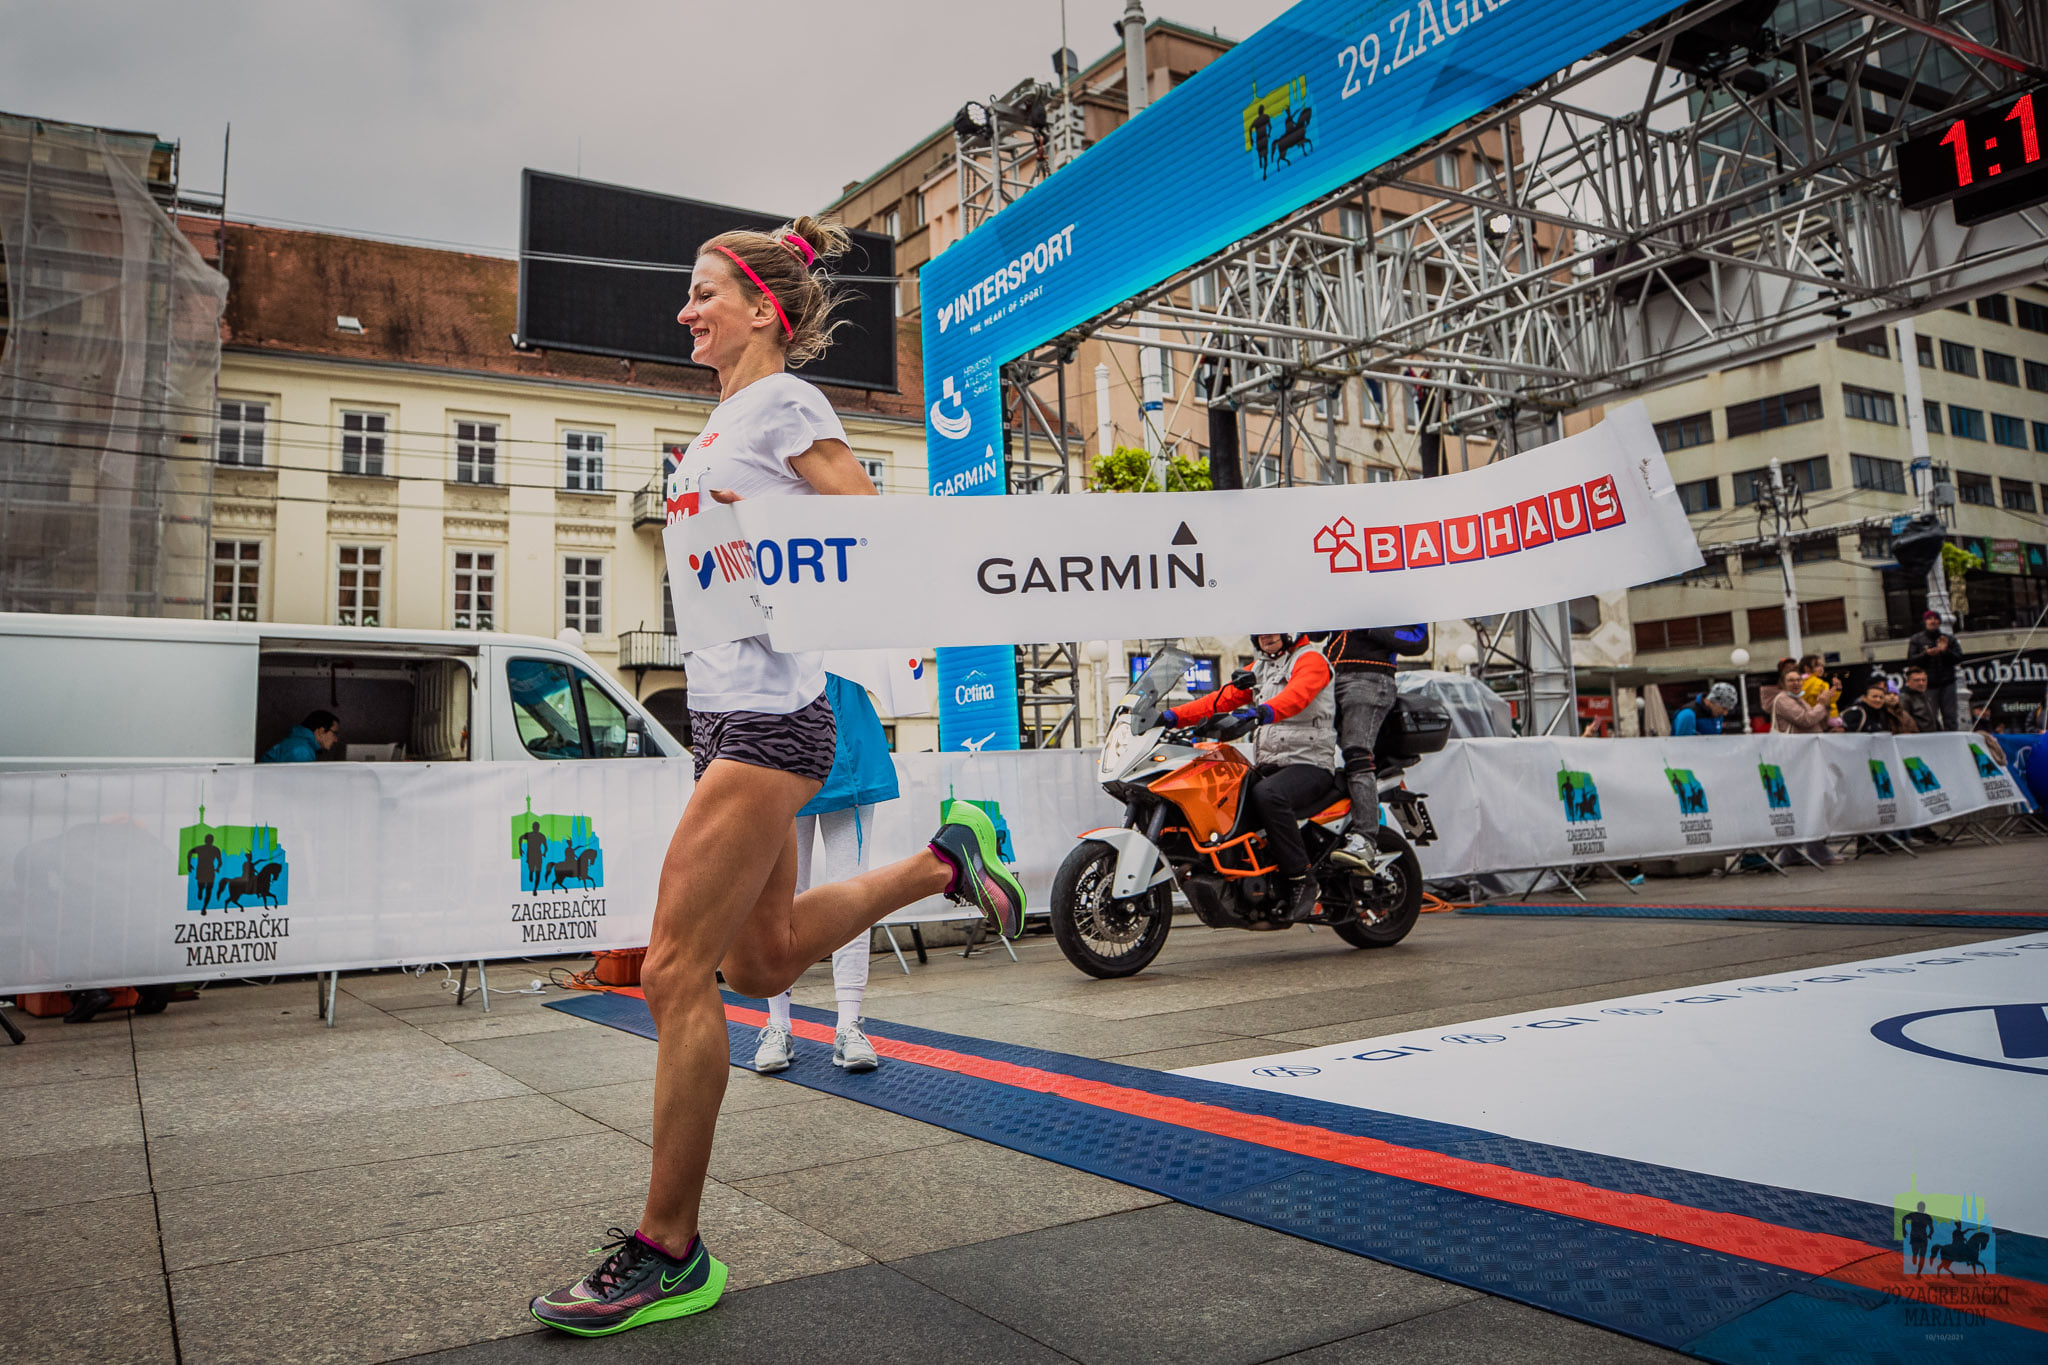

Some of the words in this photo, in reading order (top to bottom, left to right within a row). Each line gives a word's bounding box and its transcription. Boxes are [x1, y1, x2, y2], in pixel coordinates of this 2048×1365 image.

[954, 223, 1076, 324] INTERSPORT
[970, 321, 982, 335] THE
[984, 307, 1006, 328] HEART
[1008, 301, 1018, 313] OF
[1019, 285, 1044, 307] SPORT
[933, 459, 997, 496] GARMIN
[1367, 477, 1622, 568] BAUHAUS
[977, 552, 1205, 594] GARMIN
[955, 684, 995, 705] Cetina
[511, 895, 607, 922] ZAGREBAČKI
[174, 913, 290, 944] ZAGREBAČKI
[522, 920, 597, 942] MARATON
[186, 941, 278, 966] MARATON
